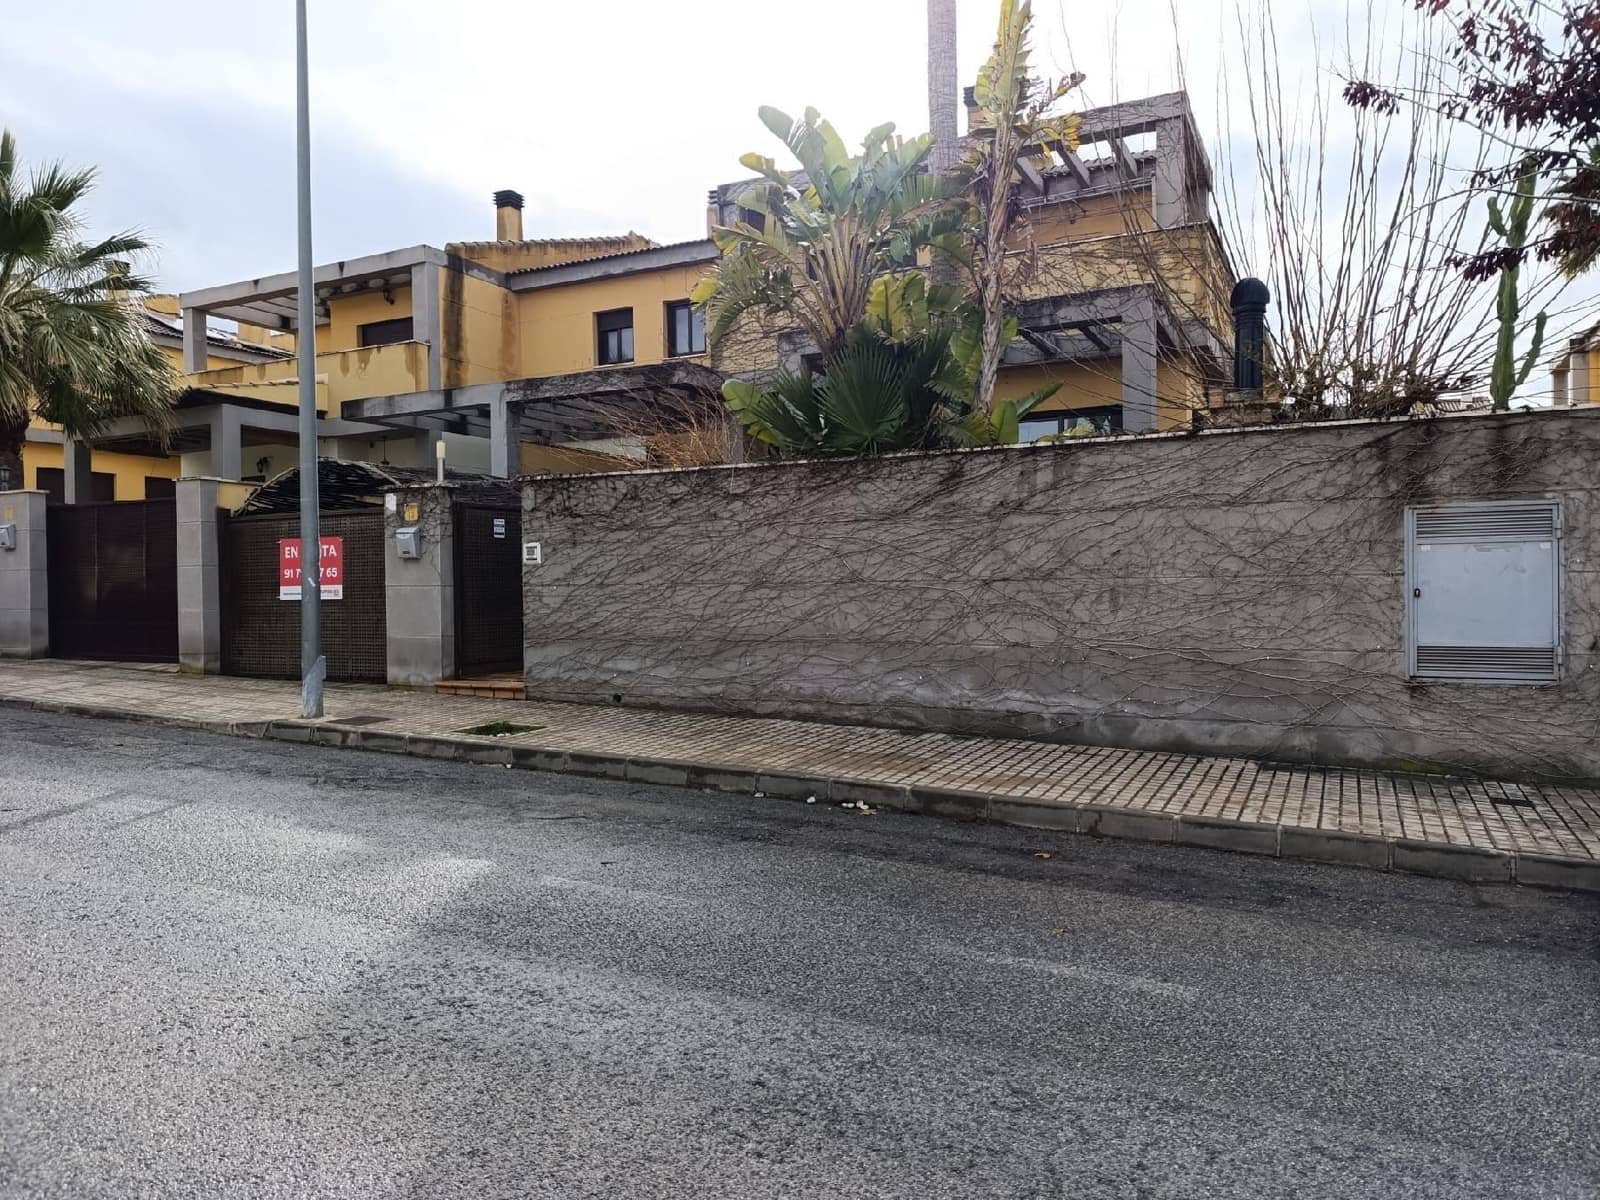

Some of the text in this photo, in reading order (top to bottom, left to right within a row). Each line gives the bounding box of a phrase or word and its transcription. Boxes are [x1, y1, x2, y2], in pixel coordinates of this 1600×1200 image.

[284, 546, 298, 558] EN
[284, 568, 294, 578] 91
[326, 567, 338, 578] 65
